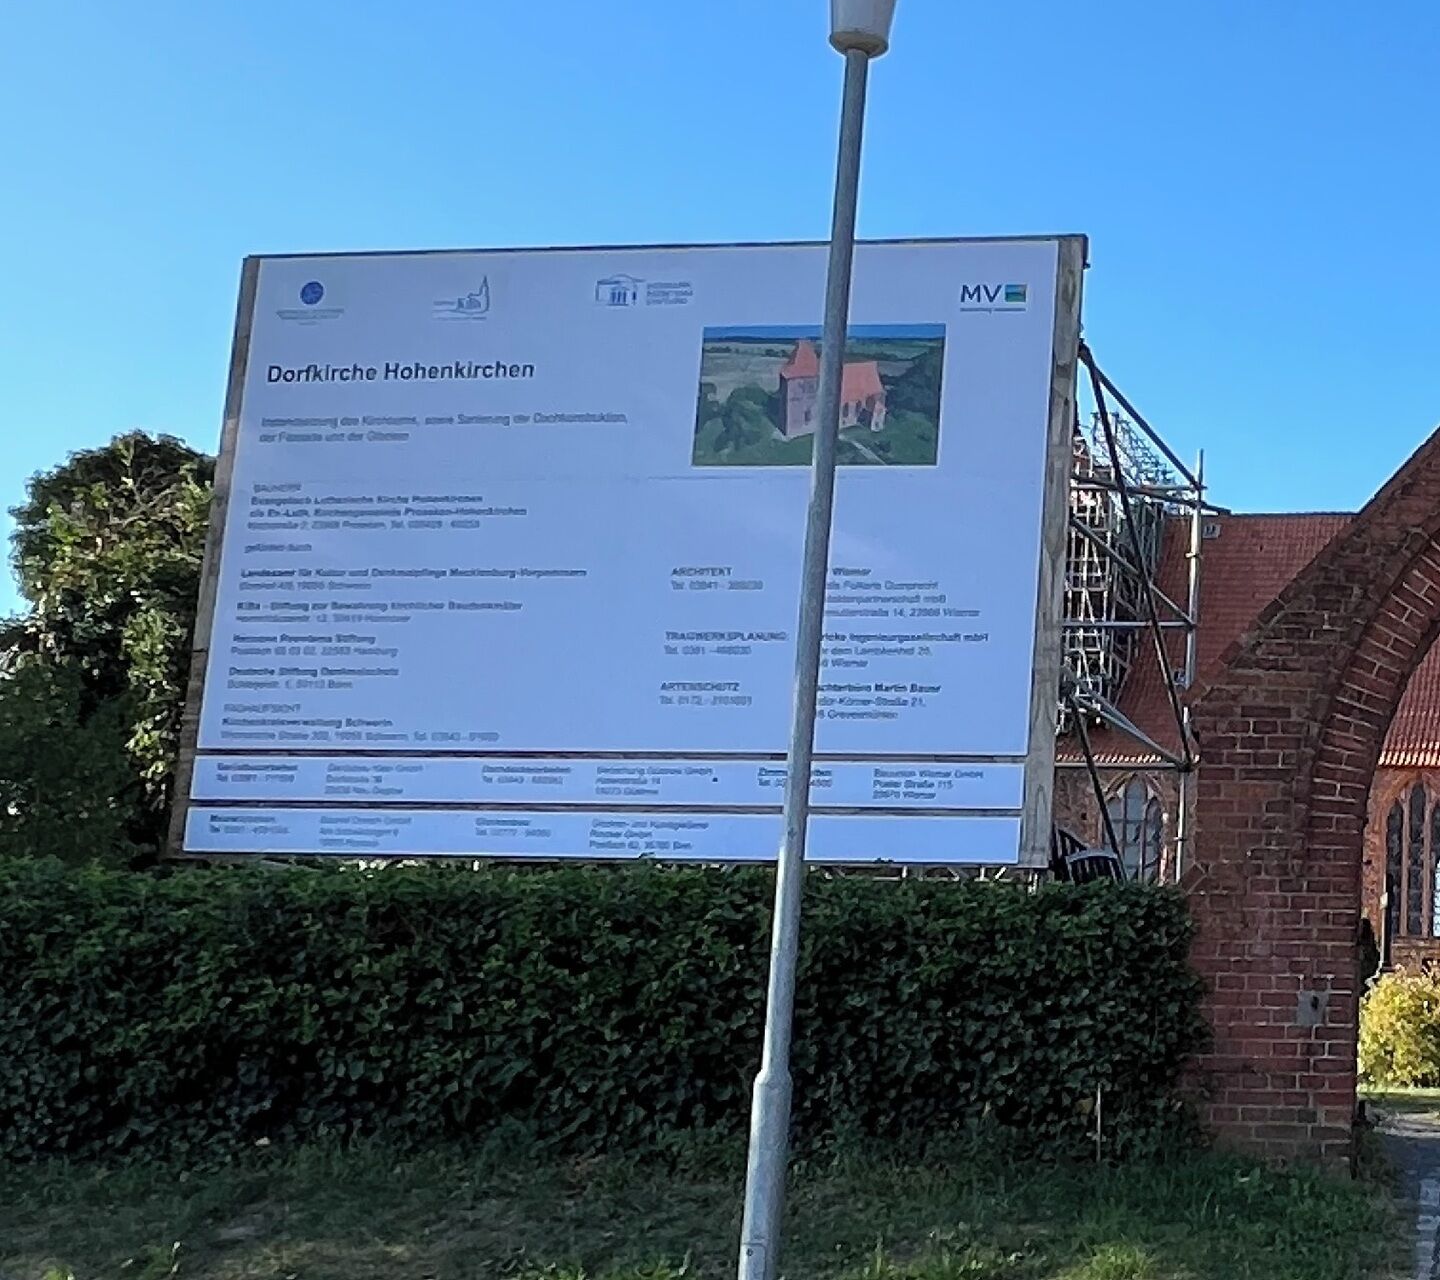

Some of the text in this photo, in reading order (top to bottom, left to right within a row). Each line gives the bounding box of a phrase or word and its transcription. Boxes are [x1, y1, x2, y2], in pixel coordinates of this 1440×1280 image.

[960, 284, 1002, 302] MV
[267, 360, 535, 383] Dorfkirche Hohenkirchen
